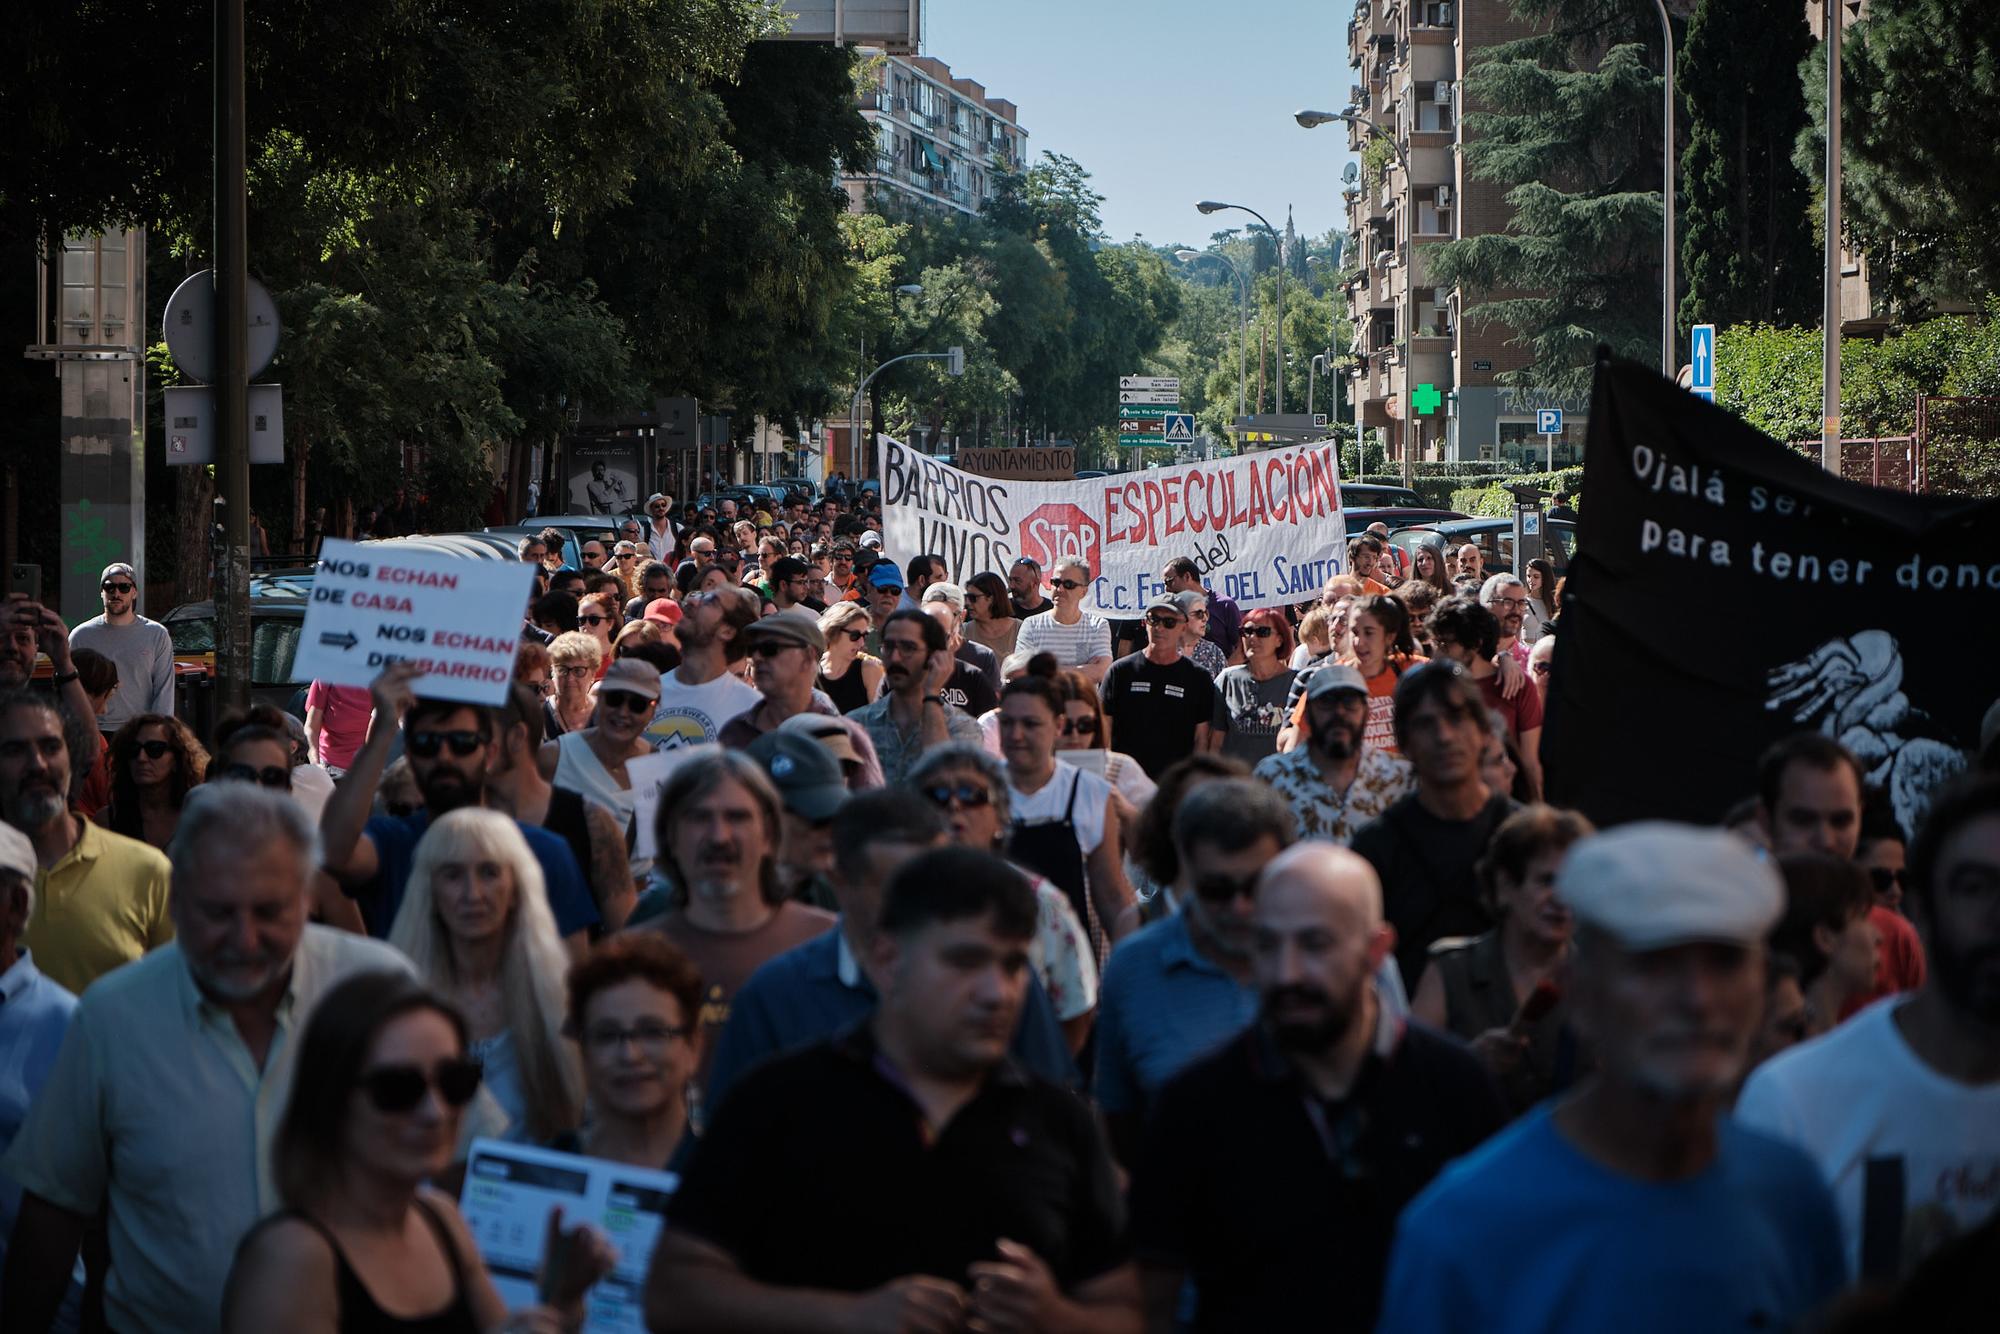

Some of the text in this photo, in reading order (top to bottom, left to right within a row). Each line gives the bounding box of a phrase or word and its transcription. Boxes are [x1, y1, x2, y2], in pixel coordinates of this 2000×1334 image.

[962, 449, 1071, 472] AYUNTAMIENTO
[1632, 444, 1726, 506] Ojalá
[885, 442, 1010, 536] BARRIOS
[1029, 518, 1096, 572] STOP
[1193, 533, 1237, 575] del
[1640, 519, 1732, 567] para
[1751, 541, 1874, 586] tener
[320, 558, 459, 590] NOS ECHAN
[1225, 571, 1266, 601] DEL
[1273, 555, 1341, 596] SANTO
[313, 586, 414, 615] DE CASA
[376, 623, 516, 655] NOS ECHAN
[415, 658, 508, 685] BARRIO
